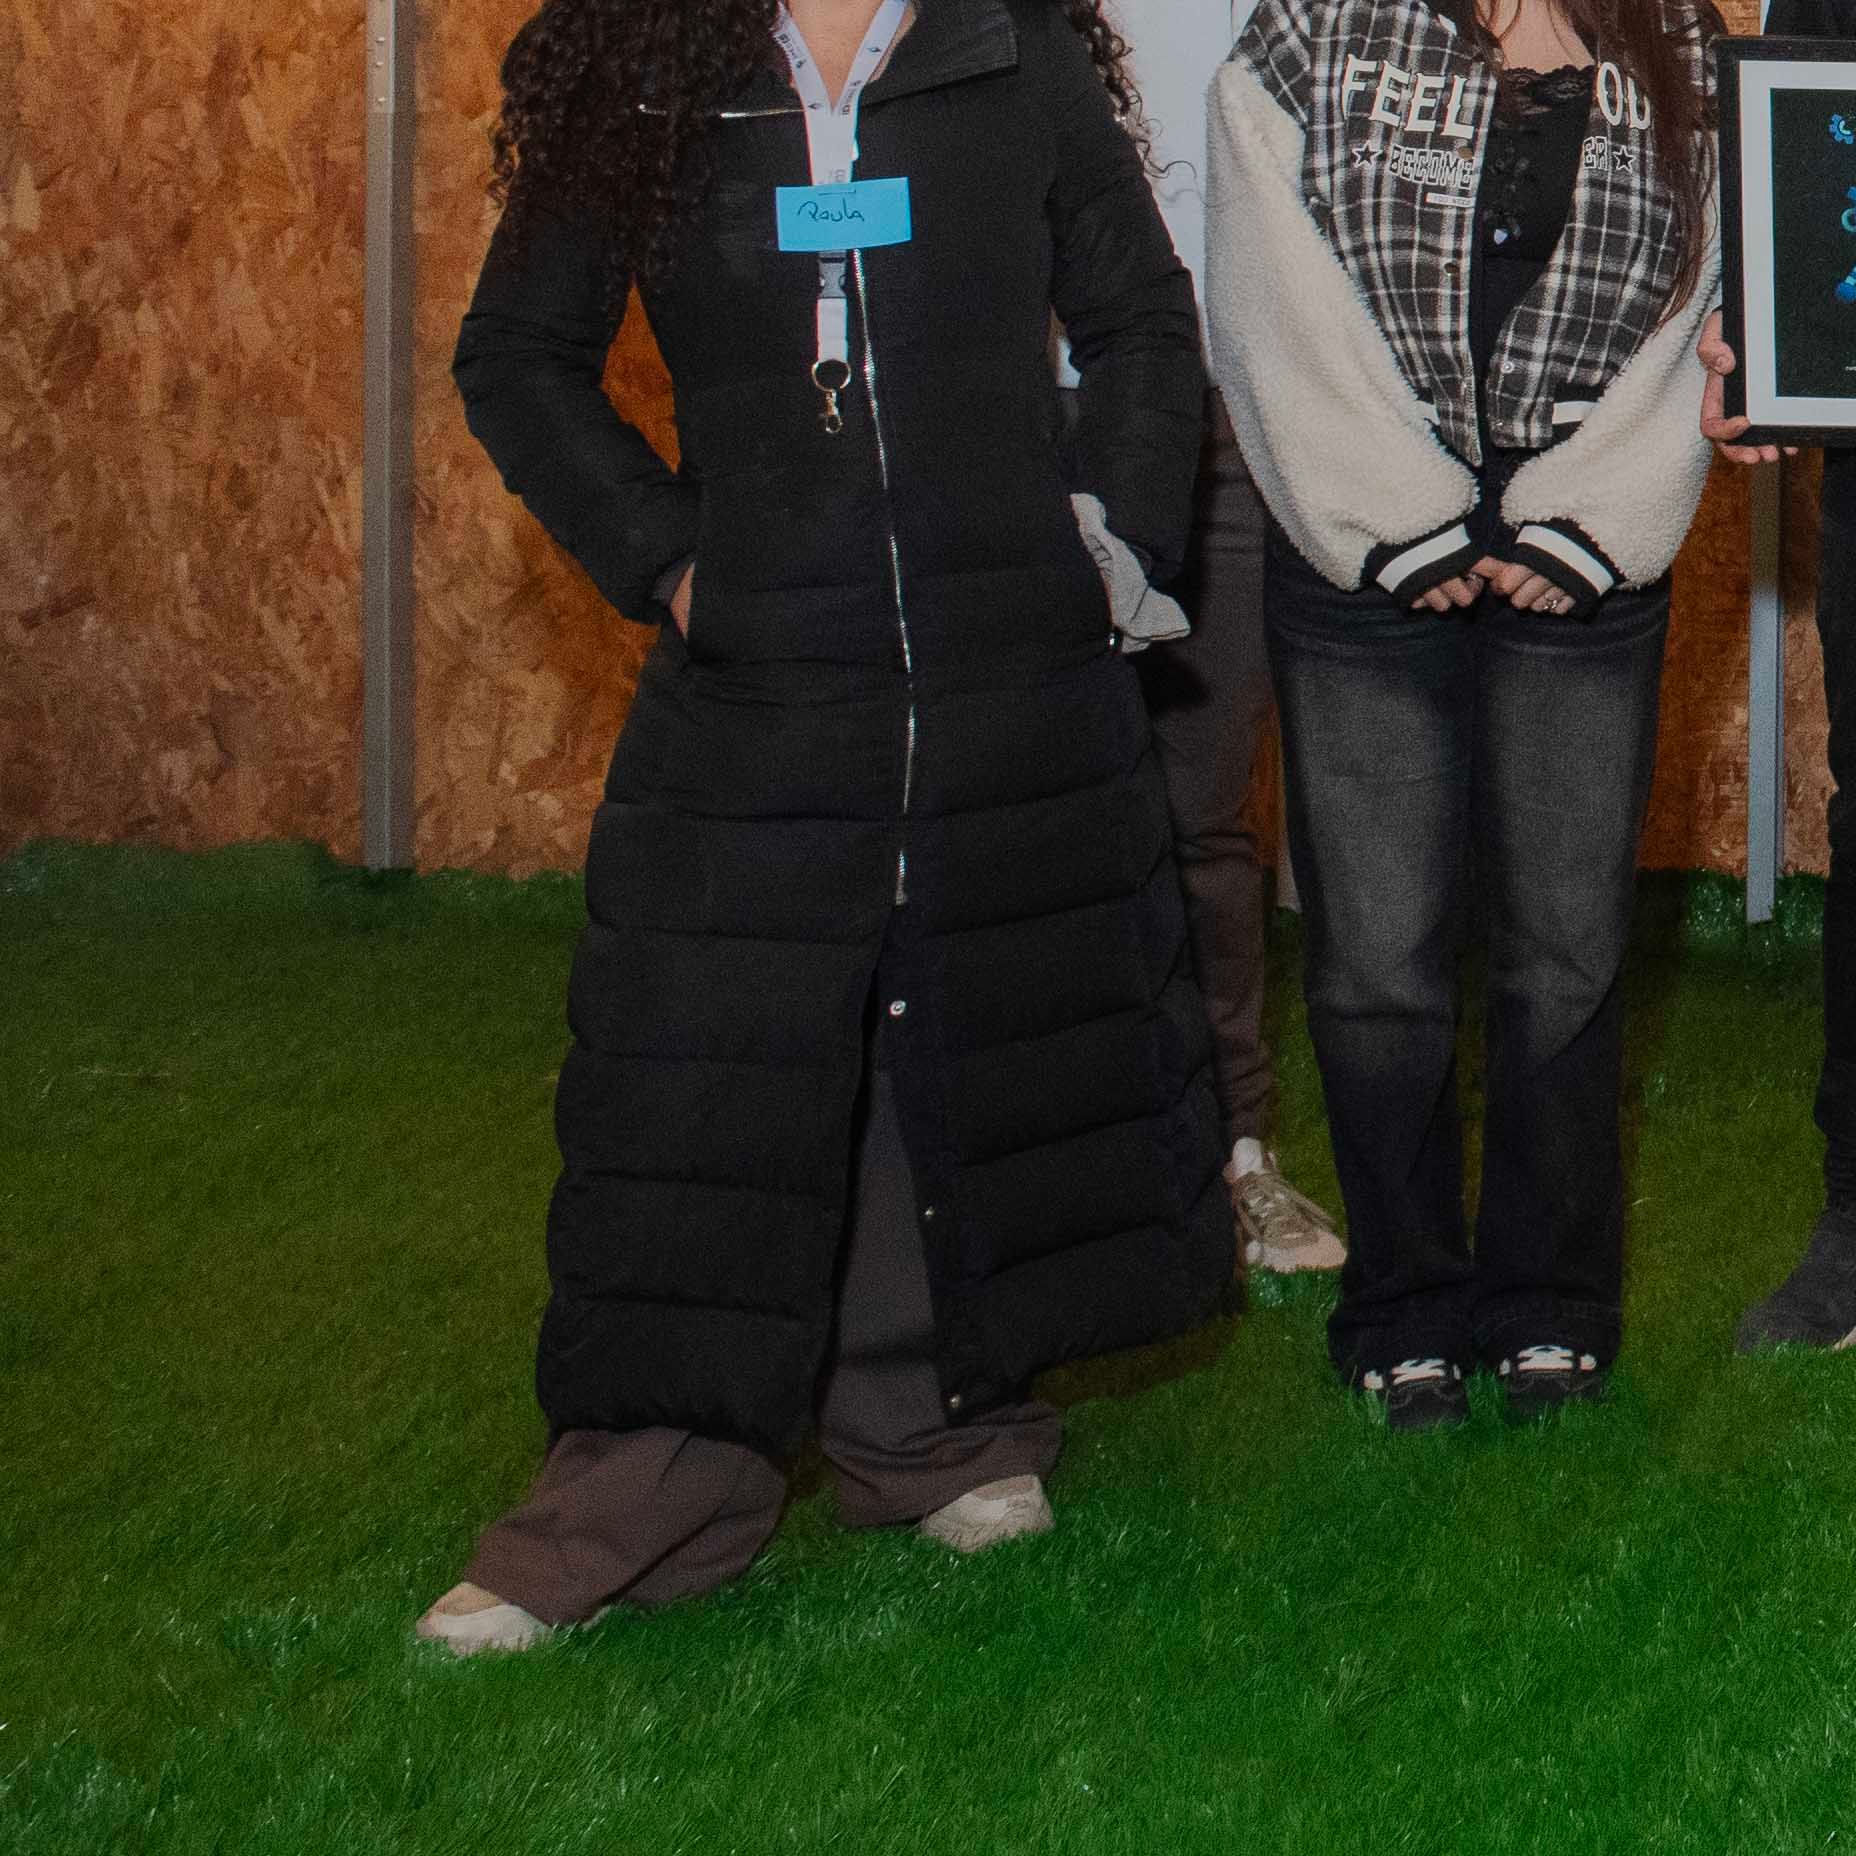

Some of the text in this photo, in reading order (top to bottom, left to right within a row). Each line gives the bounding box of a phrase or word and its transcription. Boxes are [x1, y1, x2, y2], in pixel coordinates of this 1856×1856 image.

[1342, 53, 1474, 139] FEEL
[1388, 144, 1474, 190] BECOME
[797, 197, 865, 222] Paula
